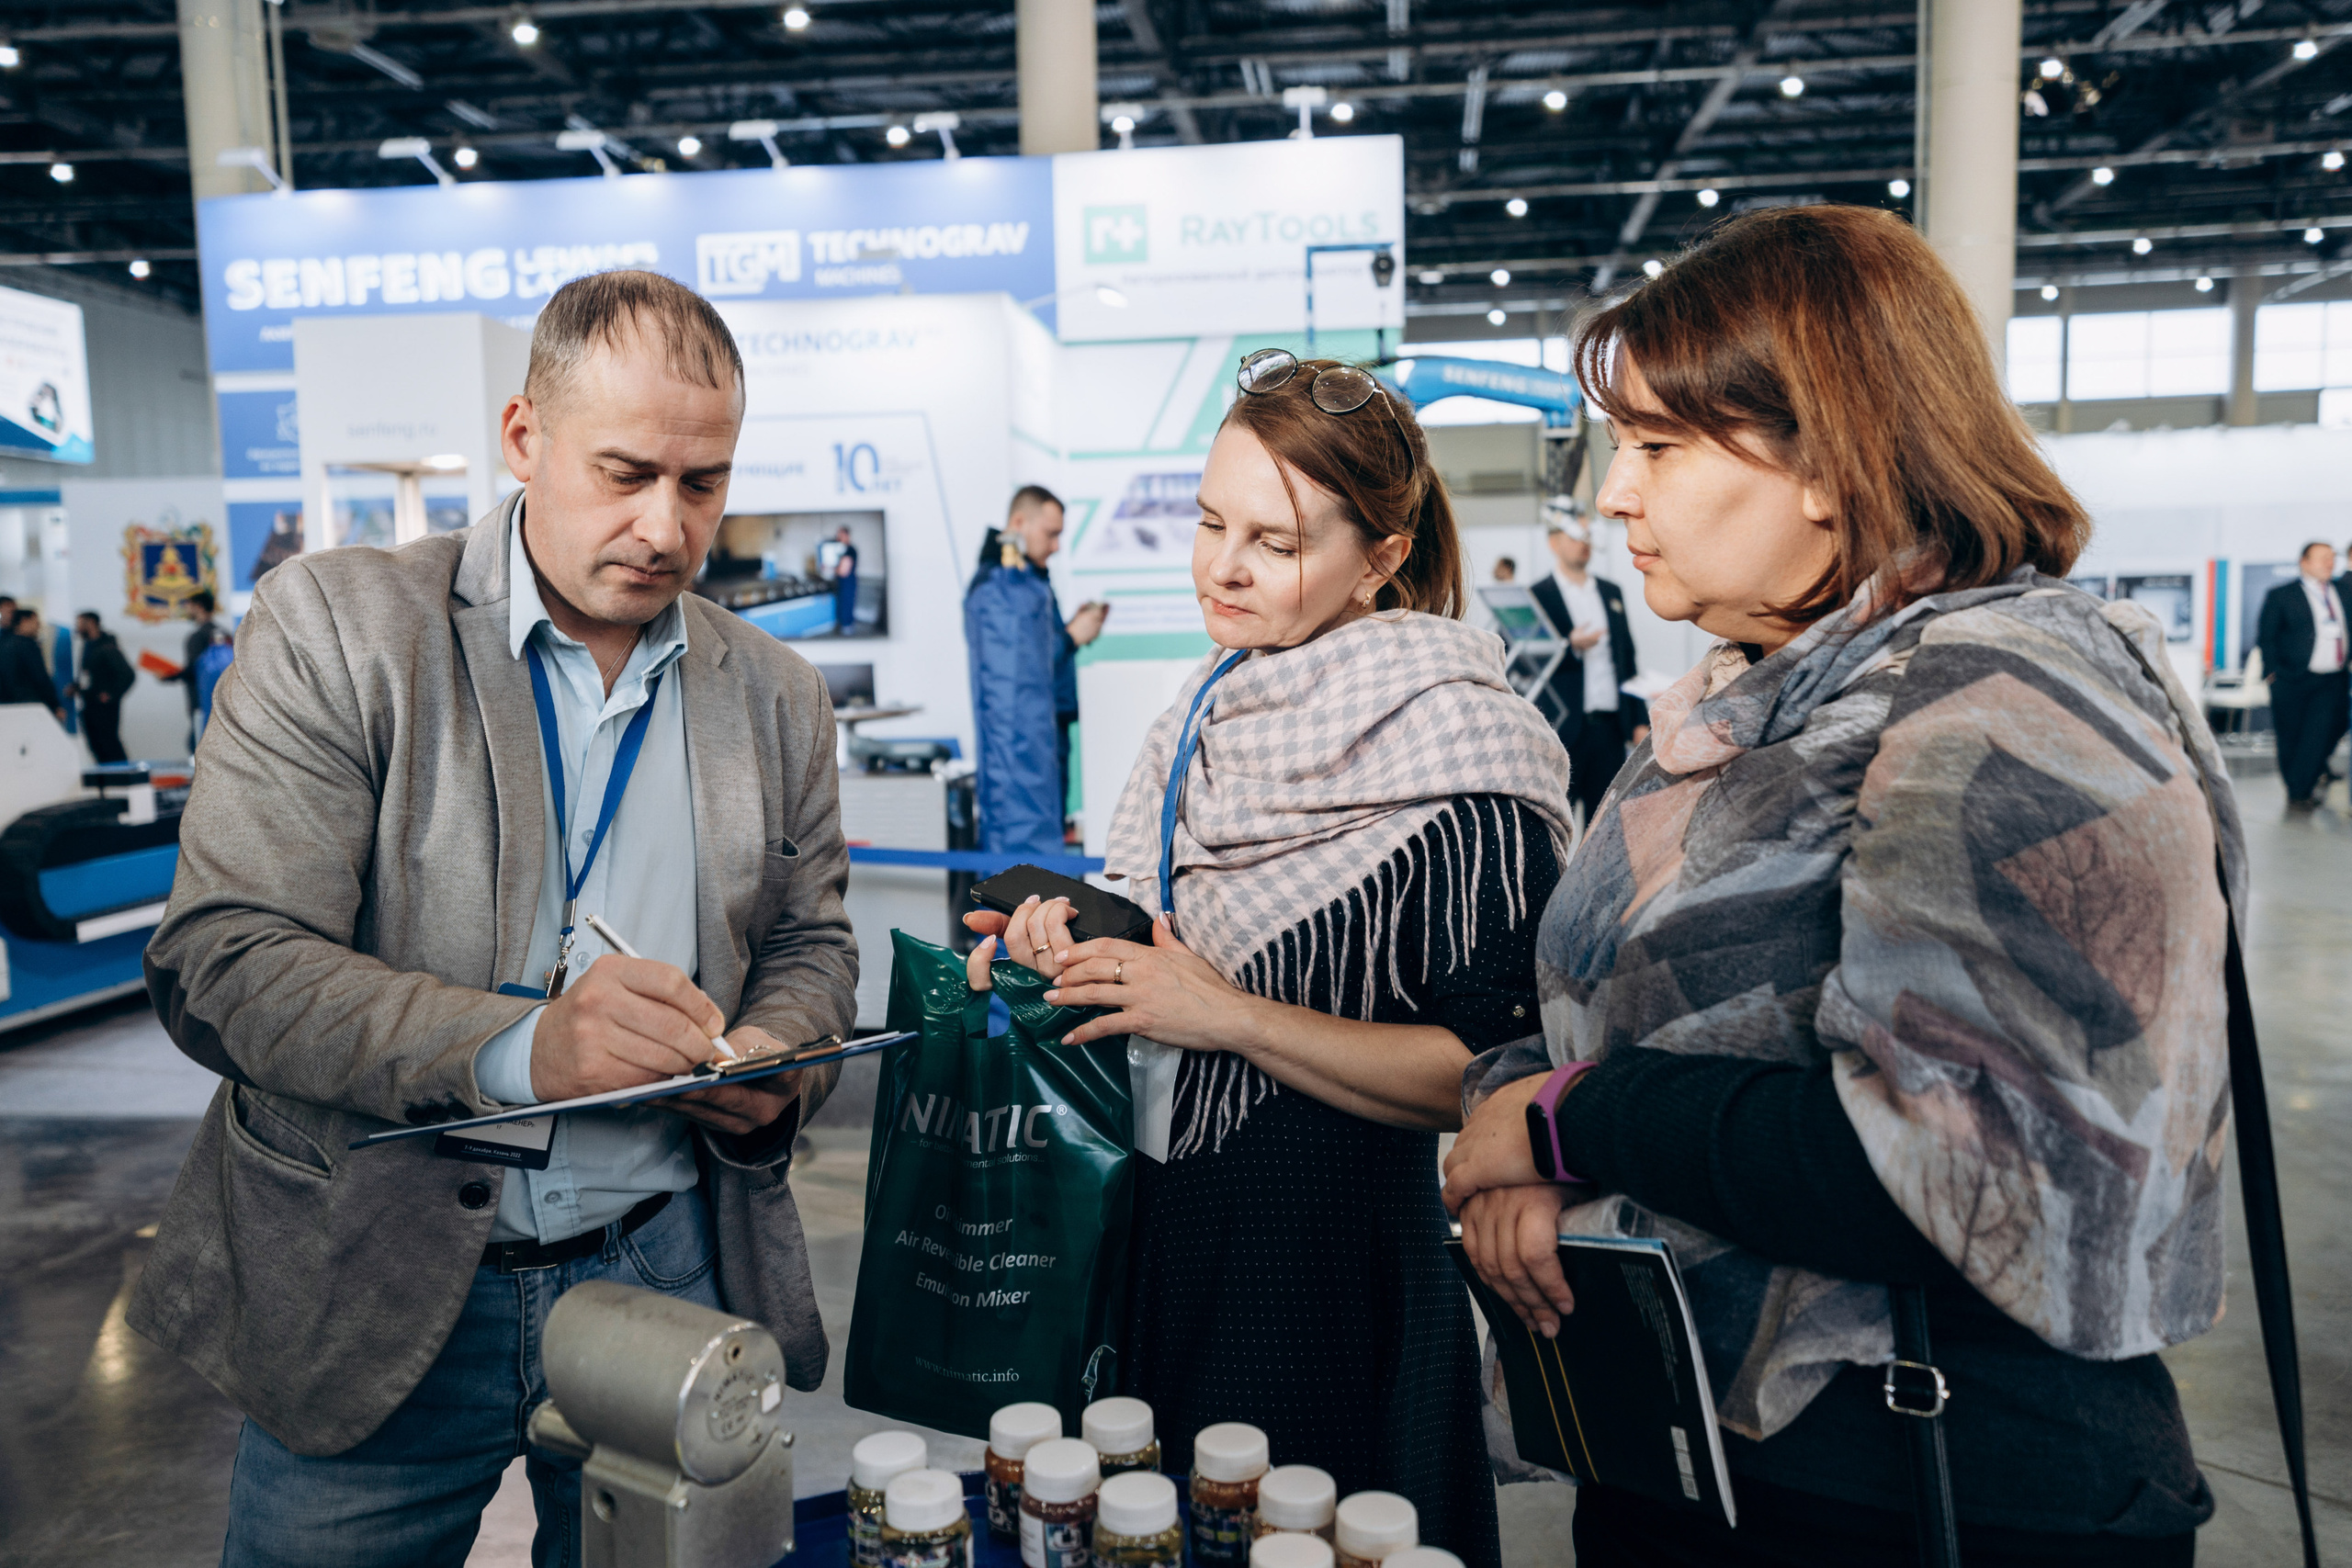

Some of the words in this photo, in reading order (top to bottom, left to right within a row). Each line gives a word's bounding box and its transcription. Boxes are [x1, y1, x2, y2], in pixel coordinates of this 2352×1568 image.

[806, 221, 1030, 264] TECHNOGRAV
[224, 247, 511, 310] SENFENG
[736, 328, 920, 358] TECHNOGRAV
[832, 443, 879, 493] 10
[895, 1230, 919, 1247] Air
[989, 1252, 1056, 1270] Cleaner
[976, 1290, 1030, 1307] Mixer
[915, 1357, 1020, 1382] www.nimatic.info
